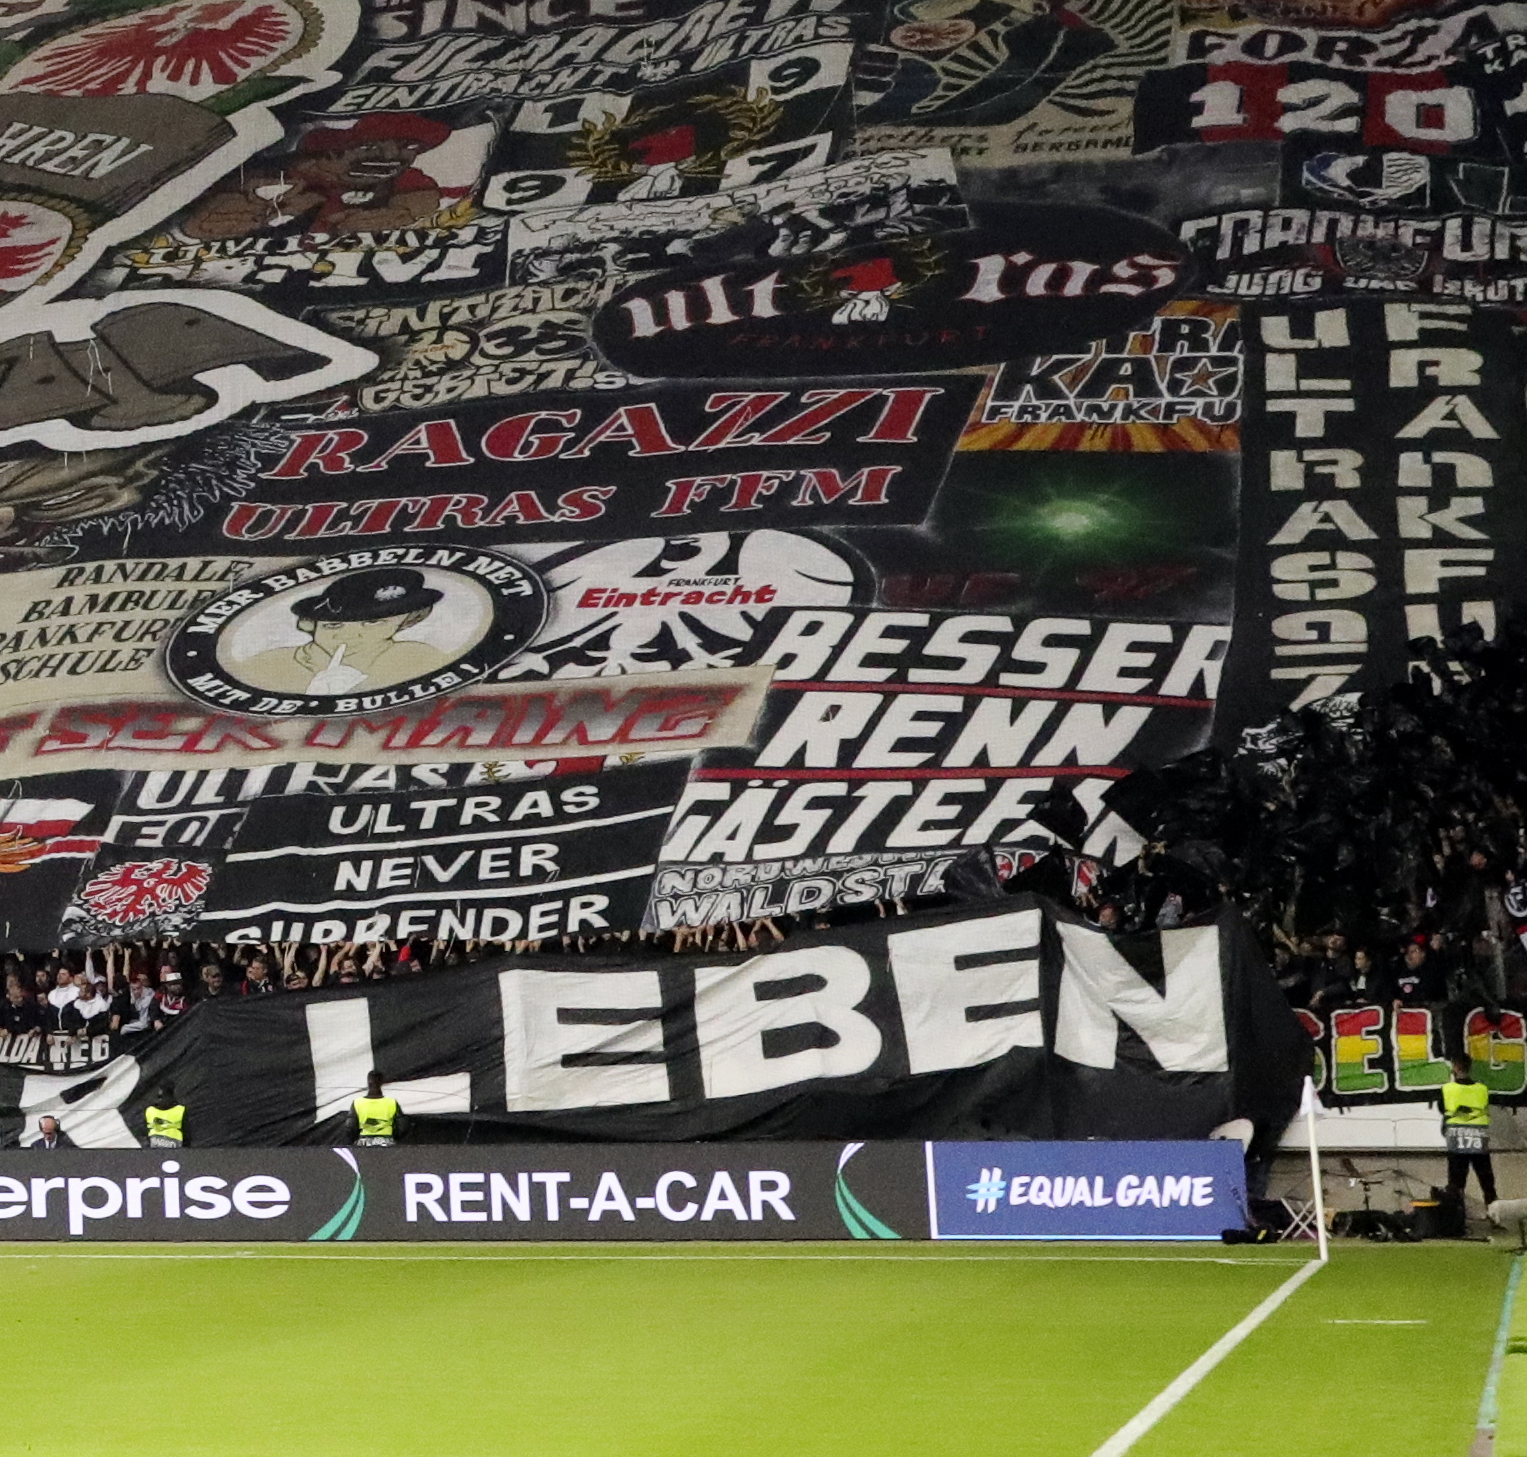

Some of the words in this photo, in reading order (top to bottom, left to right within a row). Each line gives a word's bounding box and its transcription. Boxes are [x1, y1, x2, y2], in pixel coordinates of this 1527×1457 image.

[1189, 77, 1480, 143] 120
[260, 387, 944, 481] RAGAZZI
[221, 484, 617, 544] ULTRAS
[650, 465, 903, 521] FFM
[1383, 302, 1502, 696] FRANKFU
[193, 584, 267, 638] MER
[270, 546, 459, 598] BABBELN
[462, 549, 539, 602] NET
[576, 583, 778, 610] Eintracht
[186, 668, 248, 702] MIT
[760, 607, 1233, 700] BESSER
[754, 689, 1154, 770] RENN
[327, 783, 602, 837] ULTRAS
[333, 842, 562, 894] NEVER
[305, 907, 1230, 1124] LEBEN
[403, 1170, 796, 1223] RENT-A-CAR
[965, 1166, 1114, 1214] #EQUAL
[1114, 1173, 1215, 1208] GAME
